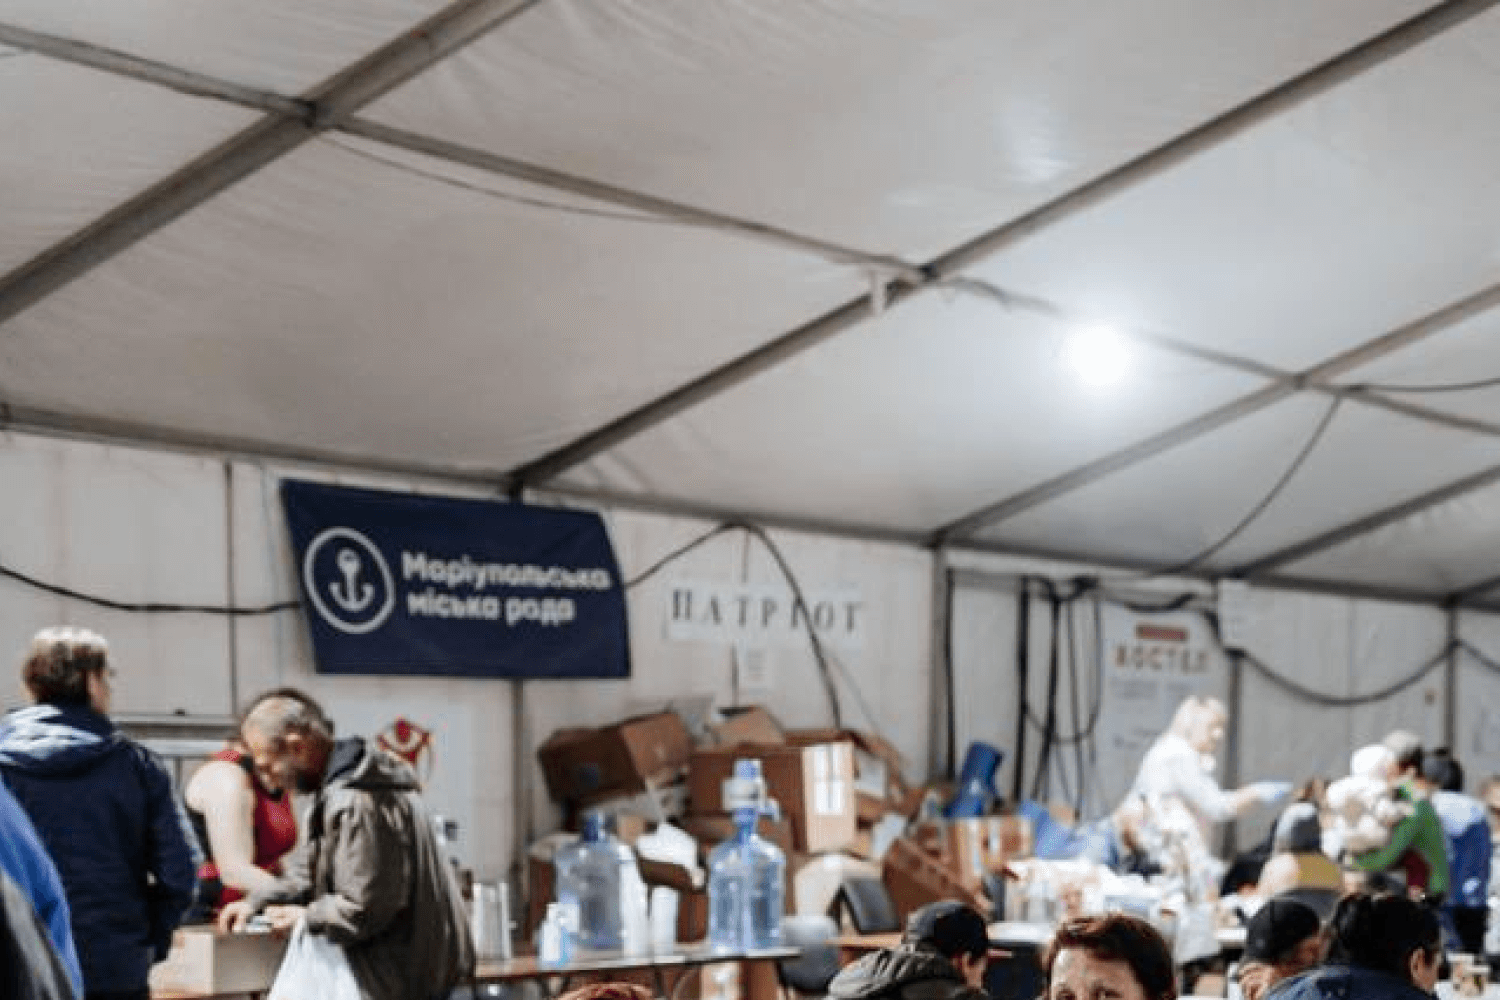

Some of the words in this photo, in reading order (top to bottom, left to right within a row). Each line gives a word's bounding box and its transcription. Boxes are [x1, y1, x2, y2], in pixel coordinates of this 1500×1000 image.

[401, 551, 612, 591] Маріупольська
[407, 588, 500, 620] міська
[506, 597, 576, 627] рада
